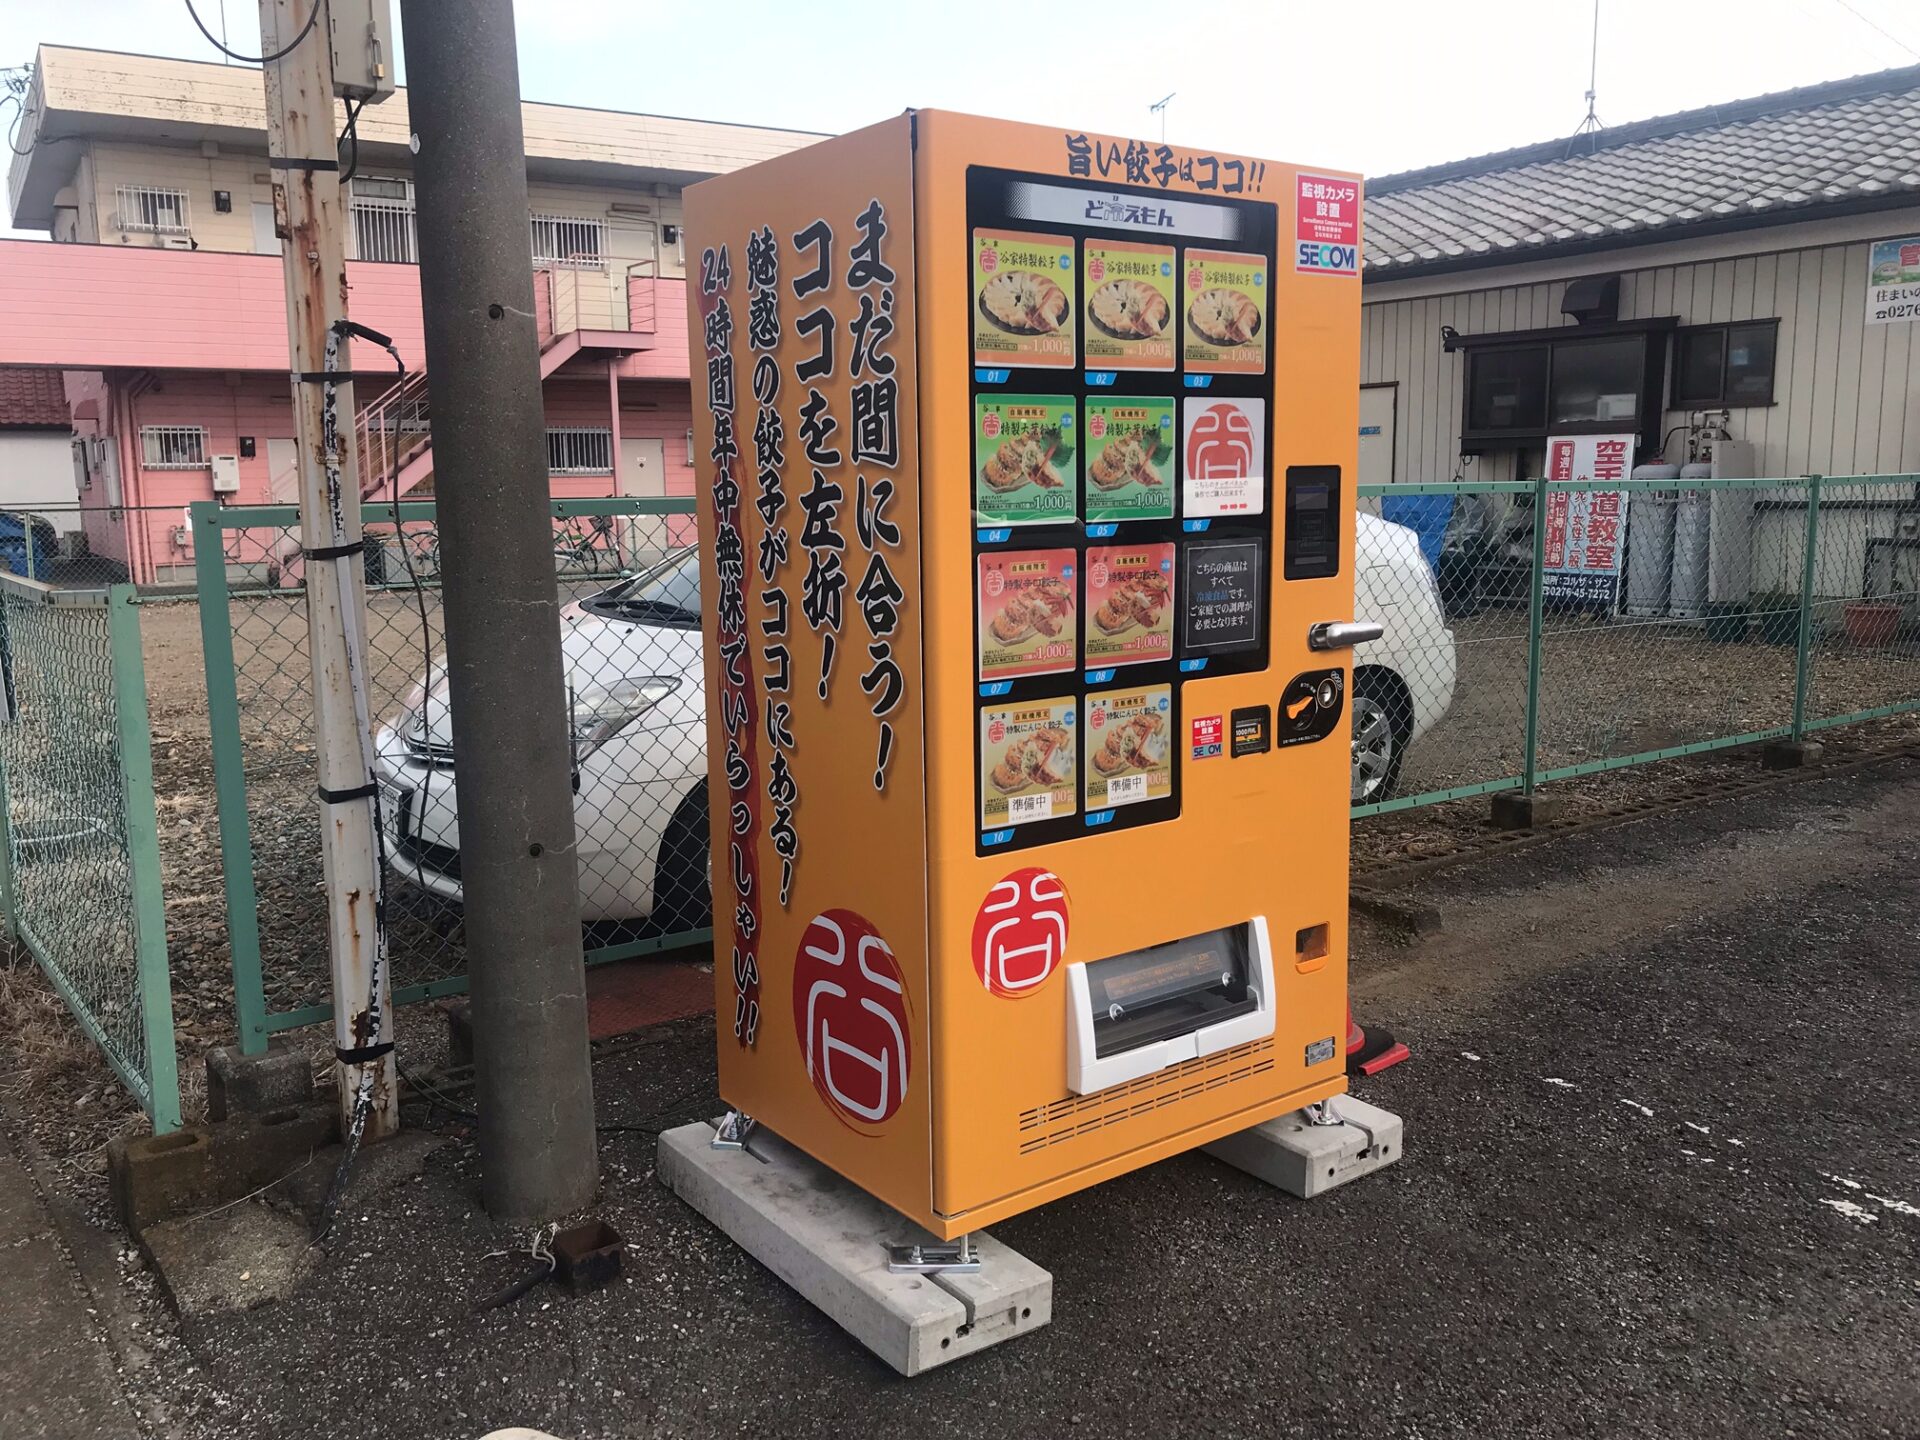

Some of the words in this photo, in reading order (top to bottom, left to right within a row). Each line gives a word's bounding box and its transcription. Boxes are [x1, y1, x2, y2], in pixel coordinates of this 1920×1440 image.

[1301, 182, 1355, 202] 監視カメラ
[1316, 201, 1340, 218] 設置
[1000, 251, 1056, 268] 谷家特製餃子
[1300, 244, 1355, 268] SECOM
[987, 371, 999, 382] 01
[1096, 373, 1107, 384] 02
[1193, 376, 1203, 386] 03
[1097, 526, 1108, 535] 05
[1192, 520, 1202, 530] 06
[989, 531, 1001, 541] 04
[1196, 560, 1248, 575] こちらの商品は
[1210, 575, 1234, 588] すべて
[1190, 600, 1253, 617] ご家庭での調理が
[1194, 615, 1248, 631] 必要となります。
[1189, 660, 1199, 670] 09
[1096, 671, 1106, 682] 08
[991, 684, 1002, 694] 07
[1006, 721, 1063, 735] 特製にんにく餃子
[1111, 776, 1142, 793] 準備中
[1012, 795, 1046, 812] 準備中
[1096, 812, 1105, 823] 11
[993, 832, 1004, 843] 10
